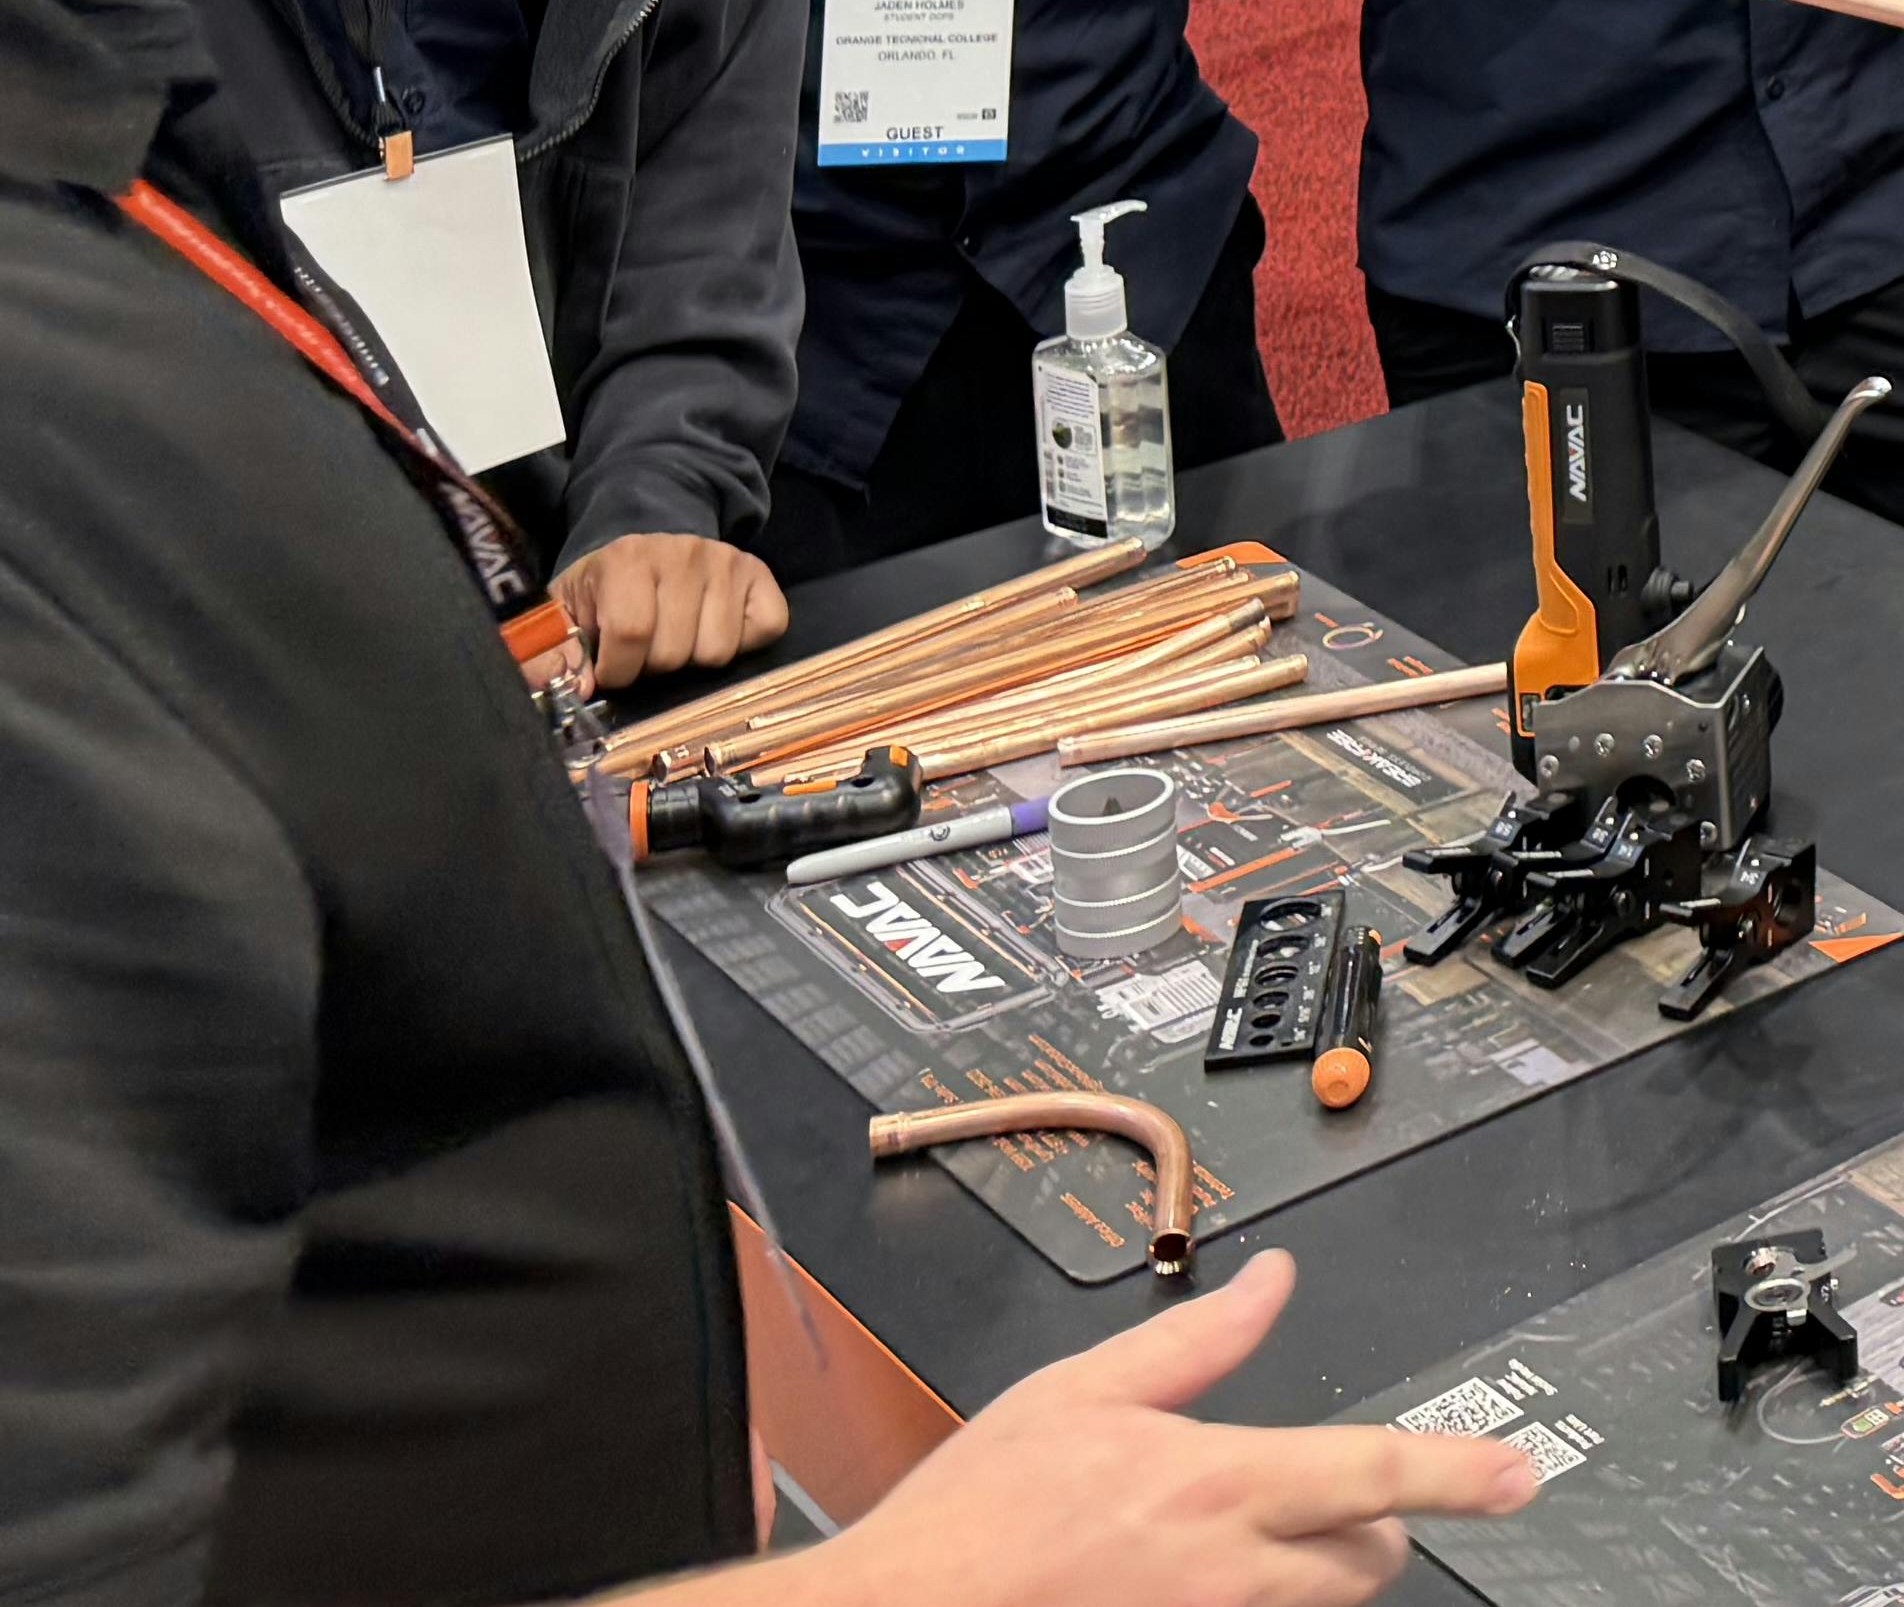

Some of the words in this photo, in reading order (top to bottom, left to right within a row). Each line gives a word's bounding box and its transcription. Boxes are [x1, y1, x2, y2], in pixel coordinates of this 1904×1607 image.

[874, 0, 913, 11] JADEN
[914, 0, 965, 11] HOLMES
[836, 36, 883, 47] ORANGE
[947, 33, 999, 44] COLLEGE
[941, 50, 956, 61] FL
[886, 125, 945, 141] GUEST
[1566, 403, 1588, 503] NAVAC
[827, 880, 1006, 996] NAVAC
